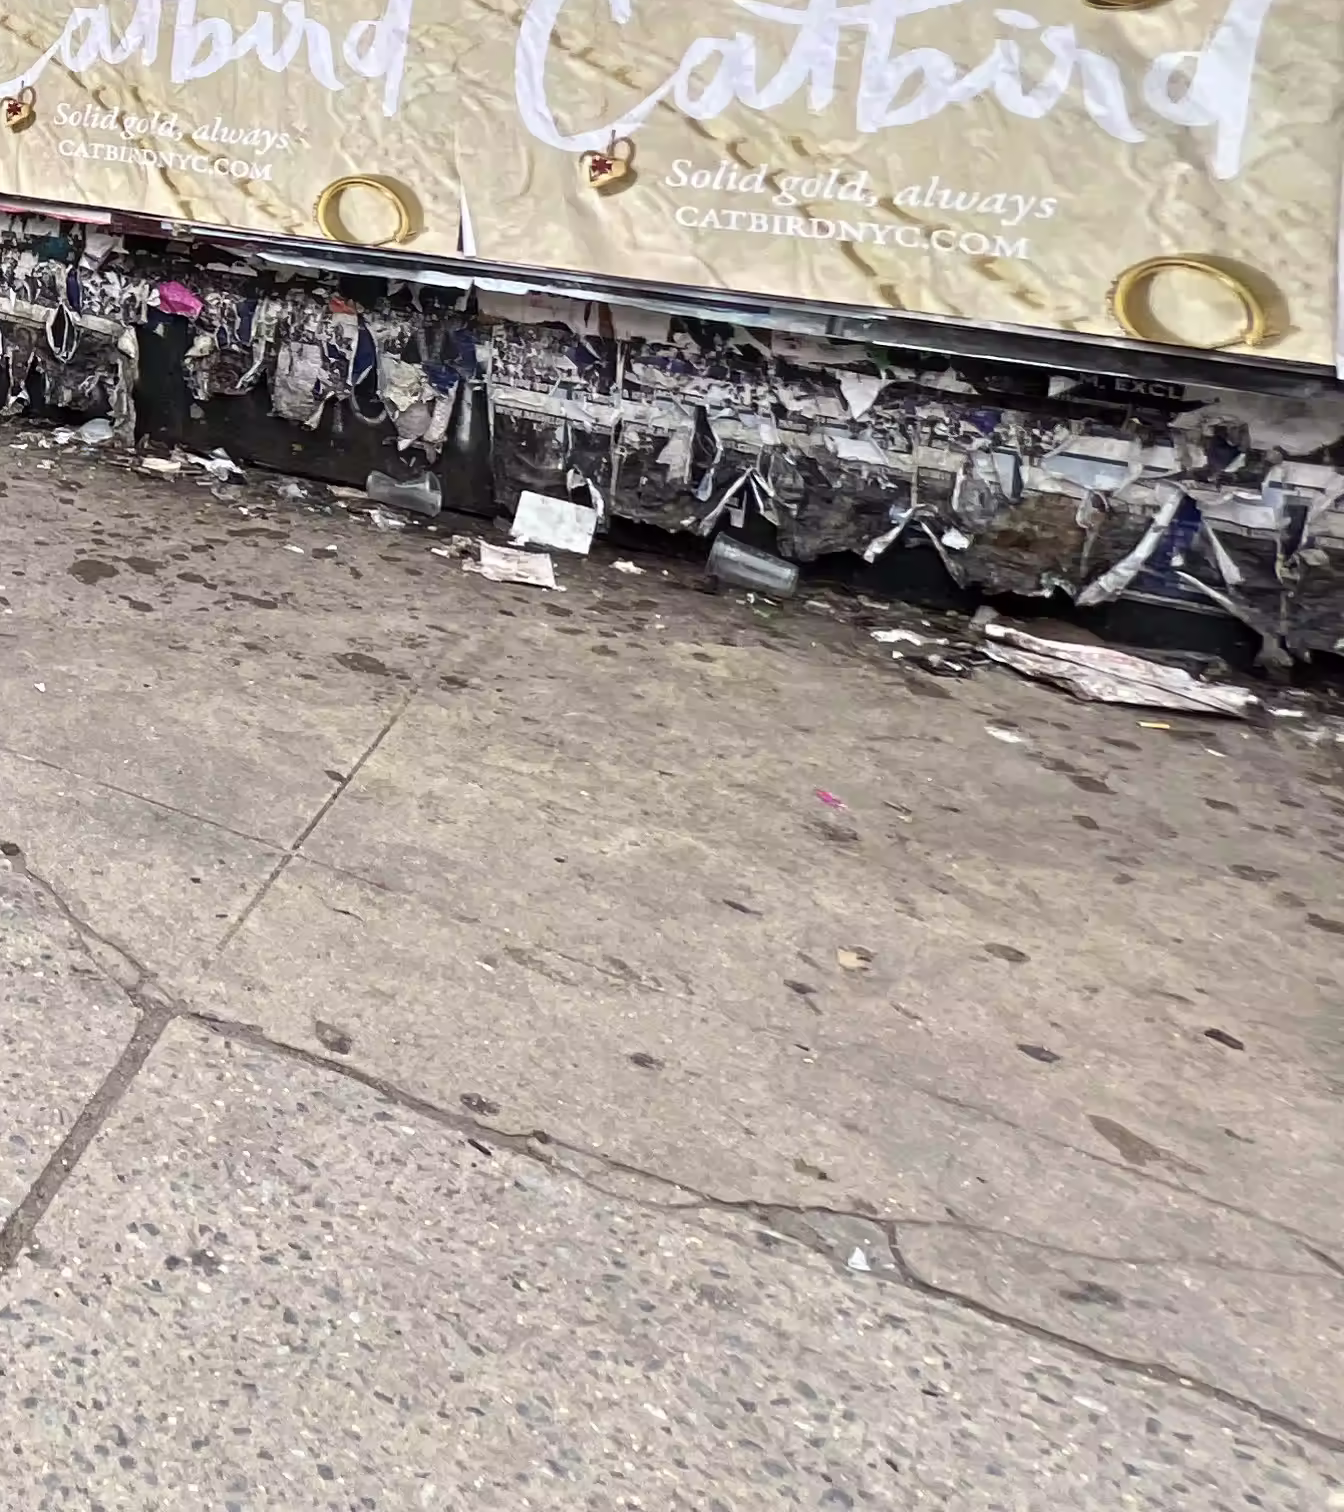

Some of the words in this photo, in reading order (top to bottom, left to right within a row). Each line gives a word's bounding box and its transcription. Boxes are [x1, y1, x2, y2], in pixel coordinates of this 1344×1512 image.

[53, 103, 120, 130] Solid
[120, 111, 184, 141] gold,
[191, 117, 291, 155] always
[59, 139, 273, 181] CATBIRDNYC.COM
[665, 158, 769, 194] Solid
[771, 169, 879, 208] gold,
[892, 175, 1059, 226] always
[675, 205, 1030, 260] CATBIRDNYC.COM
